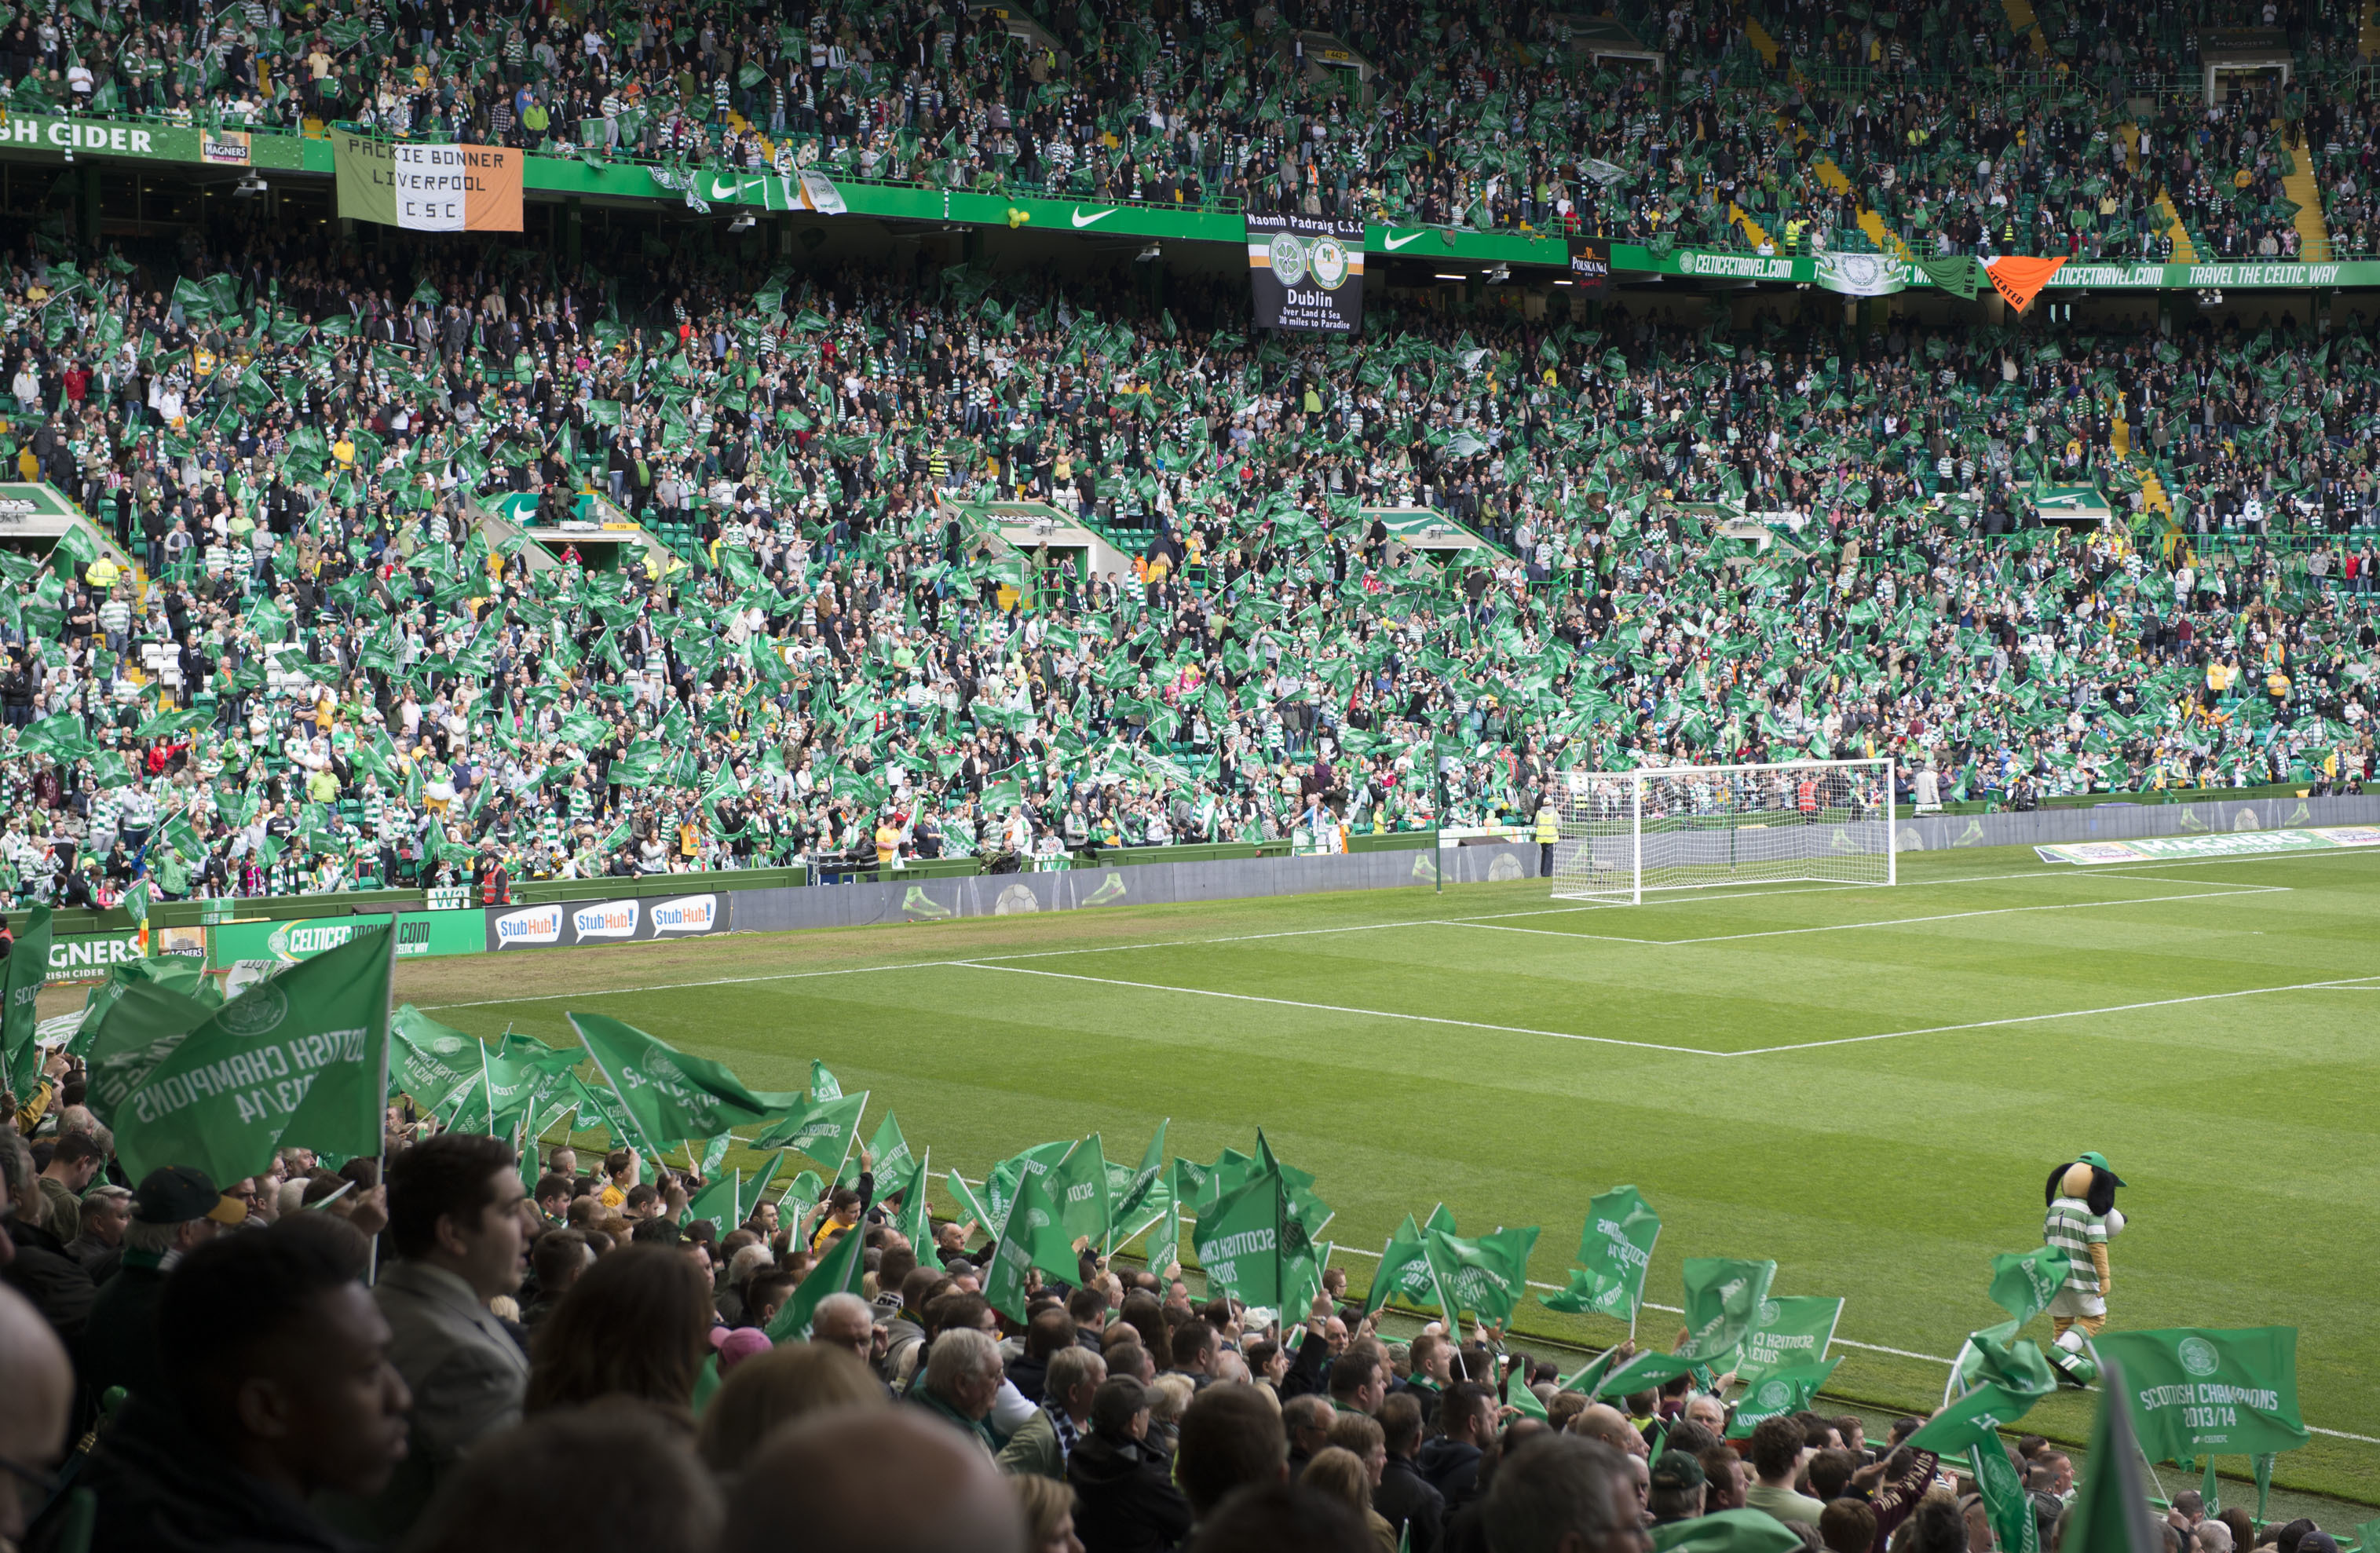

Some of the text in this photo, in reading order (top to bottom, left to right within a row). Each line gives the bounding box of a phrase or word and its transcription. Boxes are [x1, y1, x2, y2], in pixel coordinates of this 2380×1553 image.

[48, 122, 152, 152] CIDER
[206, 144, 246, 156] MAGNERS
[349, 138, 503, 168] PACKIE BONNER
[373, 170, 486, 191] LIVERPOOL
[406, 202, 462, 218] C.S.C.
[1247, 213, 1286, 227] Naomh
[1290, 215, 1334, 235] Padraig
[1572, 256, 1596, 272] POLSKA
[1695, 254, 1793, 279] CELTICFCTRAVEL.COM
[2189, 265, 2339, 284] TRAVEL THE CELTIC WAY
[1321, 280, 1338, 288] DUBLIN
[2046, 266, 2163, 285] ELTICFCTRAVEL.COM
[1288, 289, 1333, 308] Dublin
[1283, 306, 1341, 320] Over Land & Sea
[1289, 316, 1309, 327] miles
[1311, 319, 1319, 327] to
[1321, 320, 1351, 330] Paradise
[2134, 831, 2312, 853] MAGNERS
[579, 908, 634, 931] StubHub!
[656, 901, 711, 926] StubHub!
[500, 912, 558, 937] StubHub!
[49, 935, 145, 969] GNERS
[170, 948, 203, 957] AGNERS
[415, 942, 429, 953] WAY
[46, 969, 104, 980] RISH CIDER
[2057, 1209, 2066, 1237] 1
[2140, 1383, 2278, 1411] SCOTTISH CHAMPIONS
[2183, 1407, 2237, 1428] 2013/14
